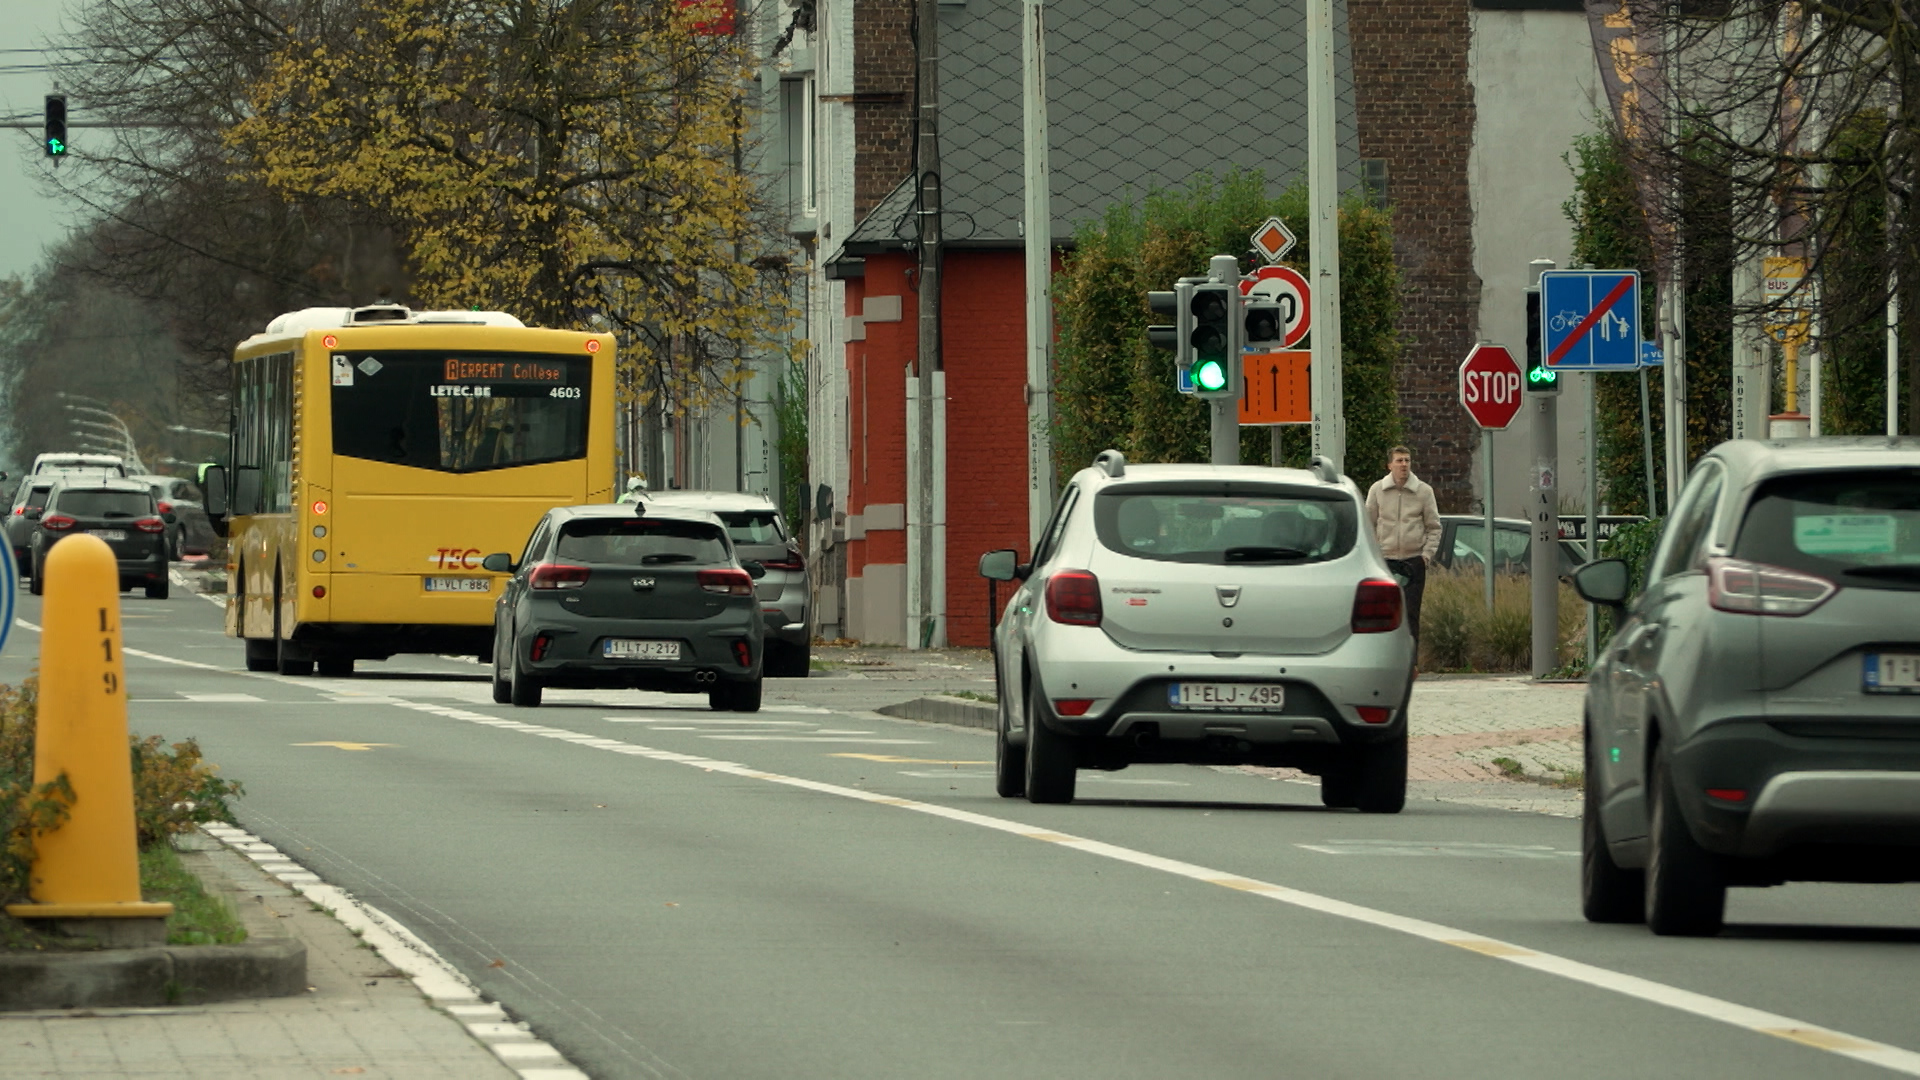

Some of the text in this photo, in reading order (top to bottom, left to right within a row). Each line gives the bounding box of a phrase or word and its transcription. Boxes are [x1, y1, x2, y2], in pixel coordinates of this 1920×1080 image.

[1767, 281, 1788, 290] BUS
[429, 385, 492, 398] LETEC.BE
[549, 387, 581, 399] 4603
[1466, 370, 1520, 404] STOP
[436, 548, 481, 570] TEC
[99, 607, 118, 694] L19
[613, 641, 678, 654] 1-LTJ-212
[1183, 686, 1281, 704] 1-ELJ-495
